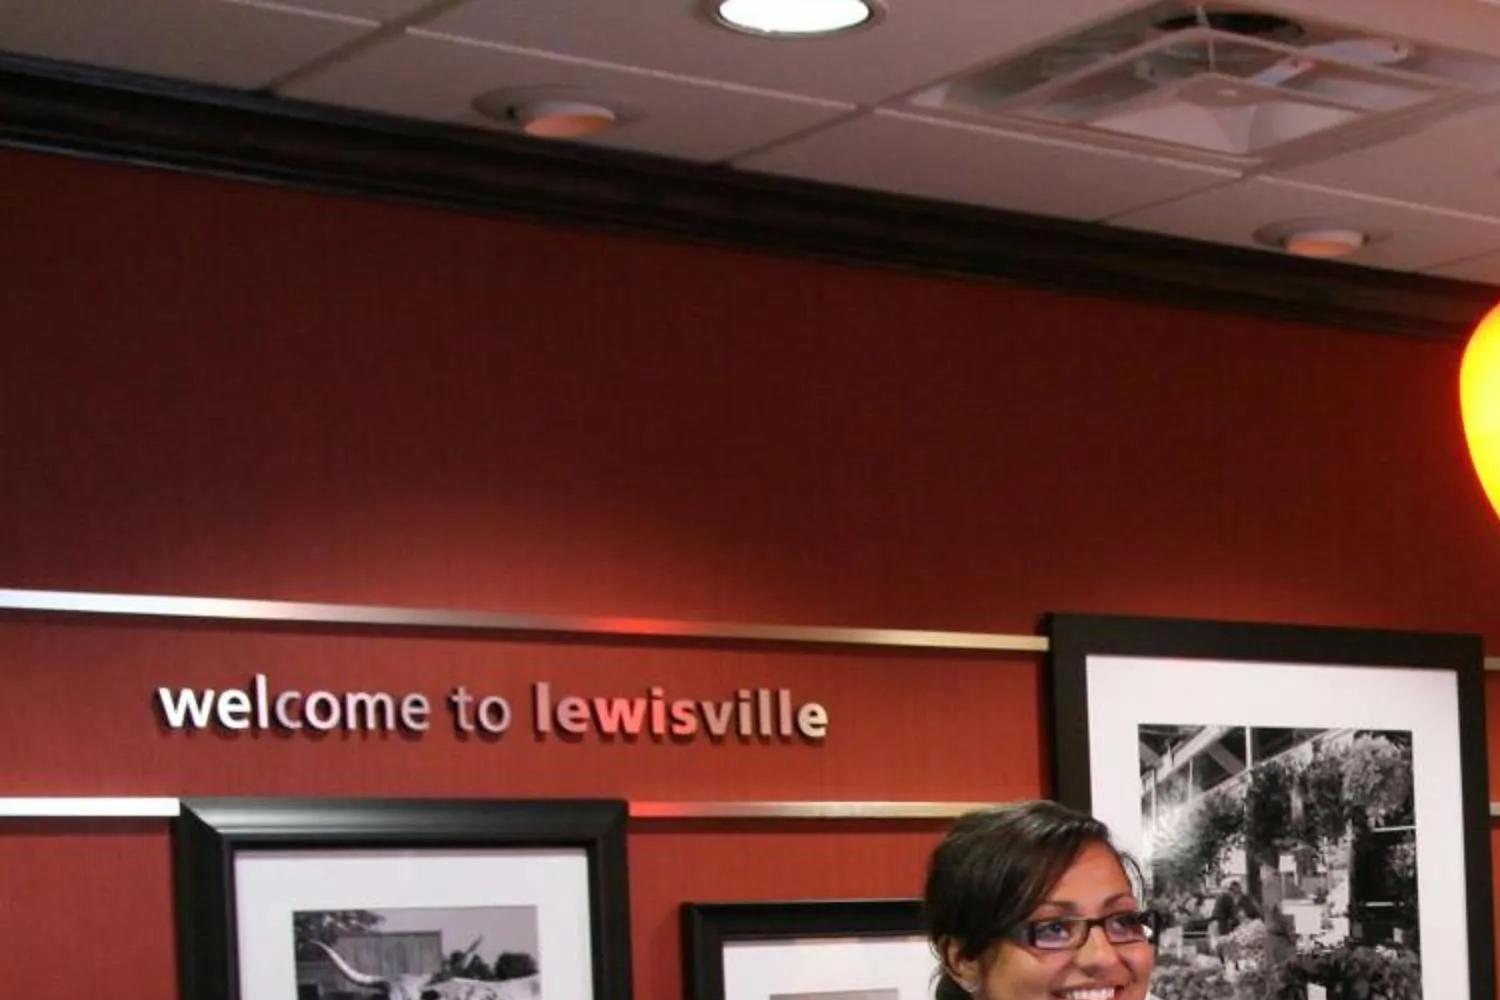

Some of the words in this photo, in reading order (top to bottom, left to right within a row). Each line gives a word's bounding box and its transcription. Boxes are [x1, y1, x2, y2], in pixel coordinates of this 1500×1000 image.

[158, 673, 430, 731] welcome
[451, 686, 511, 733] to
[534, 681, 829, 739] lewisville
